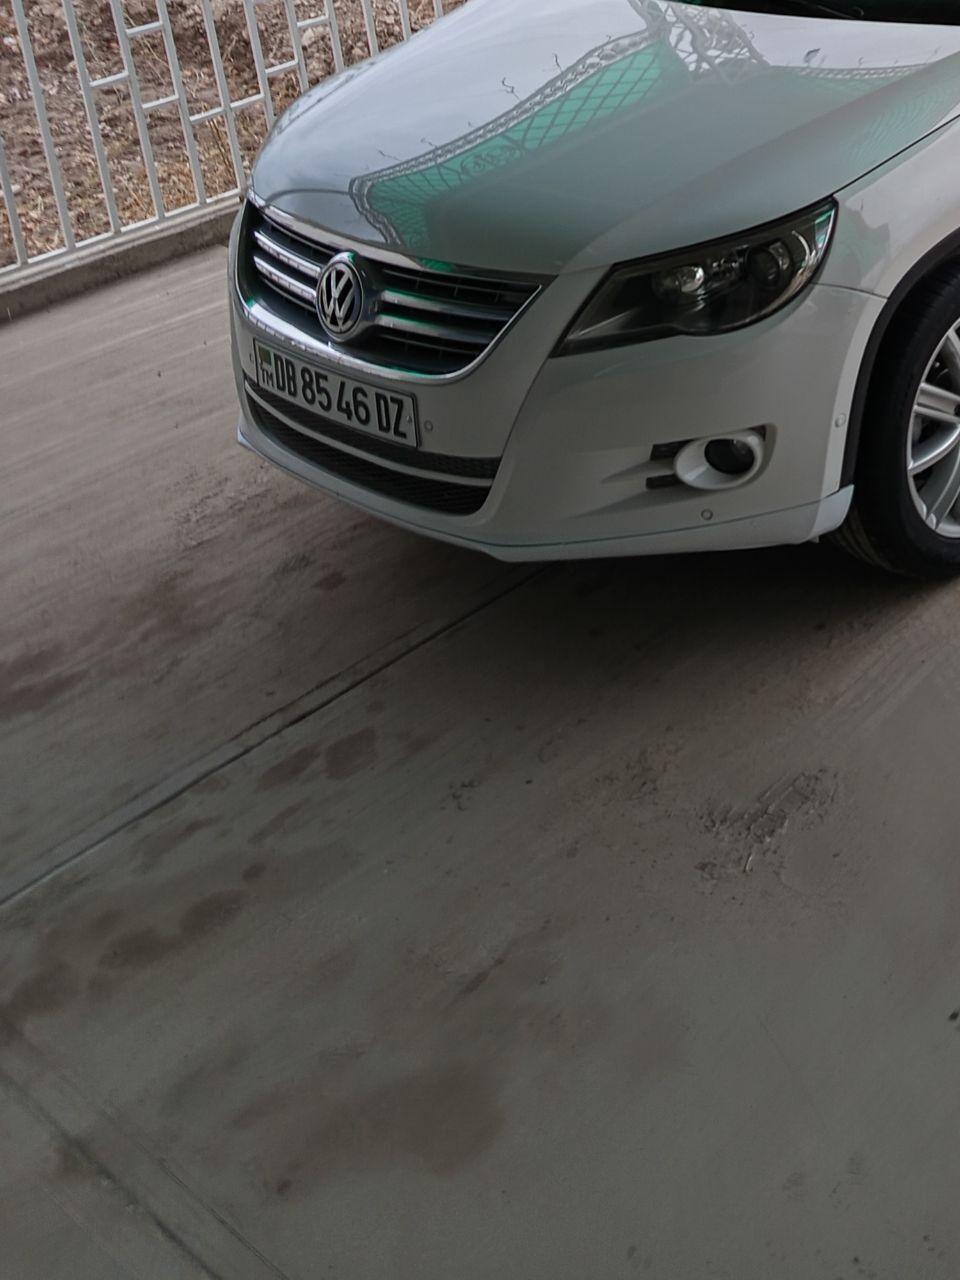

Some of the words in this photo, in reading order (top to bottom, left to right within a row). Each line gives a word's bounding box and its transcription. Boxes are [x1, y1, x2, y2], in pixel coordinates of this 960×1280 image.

[319, 261, 358, 334] VW
[273, 352, 298, 398] DB
[301, 366, 332, 413] 85
[336, 380, 371, 426] 46
[374, 391, 408, 439] DZ
